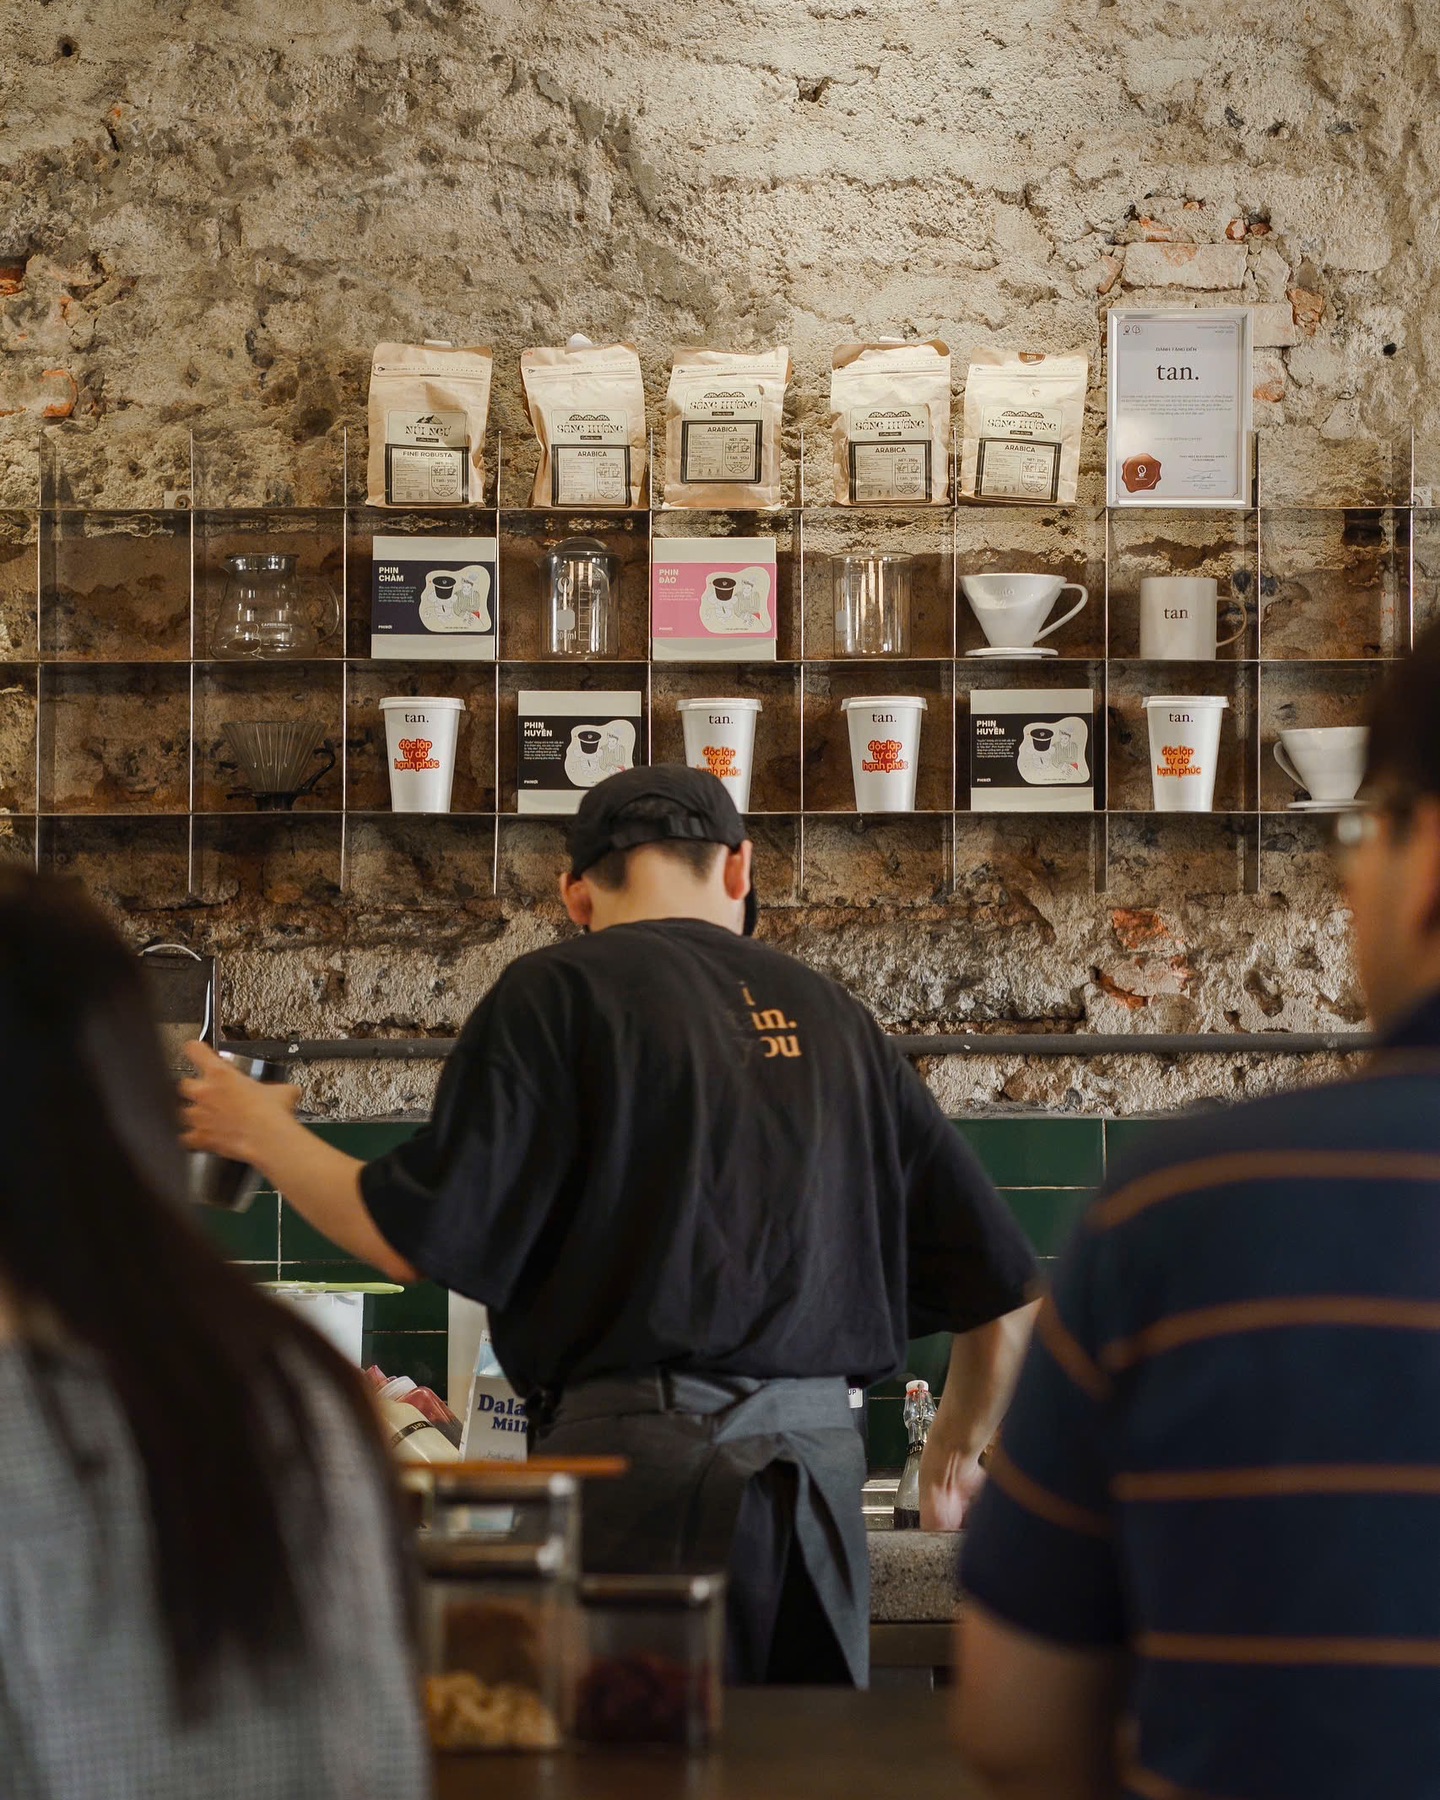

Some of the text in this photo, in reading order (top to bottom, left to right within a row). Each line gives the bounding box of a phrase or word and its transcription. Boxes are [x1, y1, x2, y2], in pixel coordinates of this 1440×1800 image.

[1156, 365, 1199, 380] tan.
[1005, 445, 1036, 453] ARABICA
[379, 574, 404, 582] CHÀM
[405, 714, 429, 723] tan.
[709, 715, 734, 724] tan.
[872, 714, 897, 723] tan.
[1169, 713, 1194, 722] tan.
[399, 739, 432, 752] độc lập
[868, 740, 902, 752] độc lập
[404, 750, 428, 759] tự do
[703, 746, 736, 758] độc lập
[873, 751, 898, 761] tự do
[1162, 746, 1194, 758] độc lập
[394, 759, 440, 772] hạnh phúc
[707, 757, 731, 766] tự do
[1166, 756, 1190, 765] tự do
[862, 760, 908, 773] hạnh phúc
[1157, 766, 1201, 778] hạnh phúc
[760, 1035, 802, 1058] ou
[478, 1394, 527, 1417] Dala
